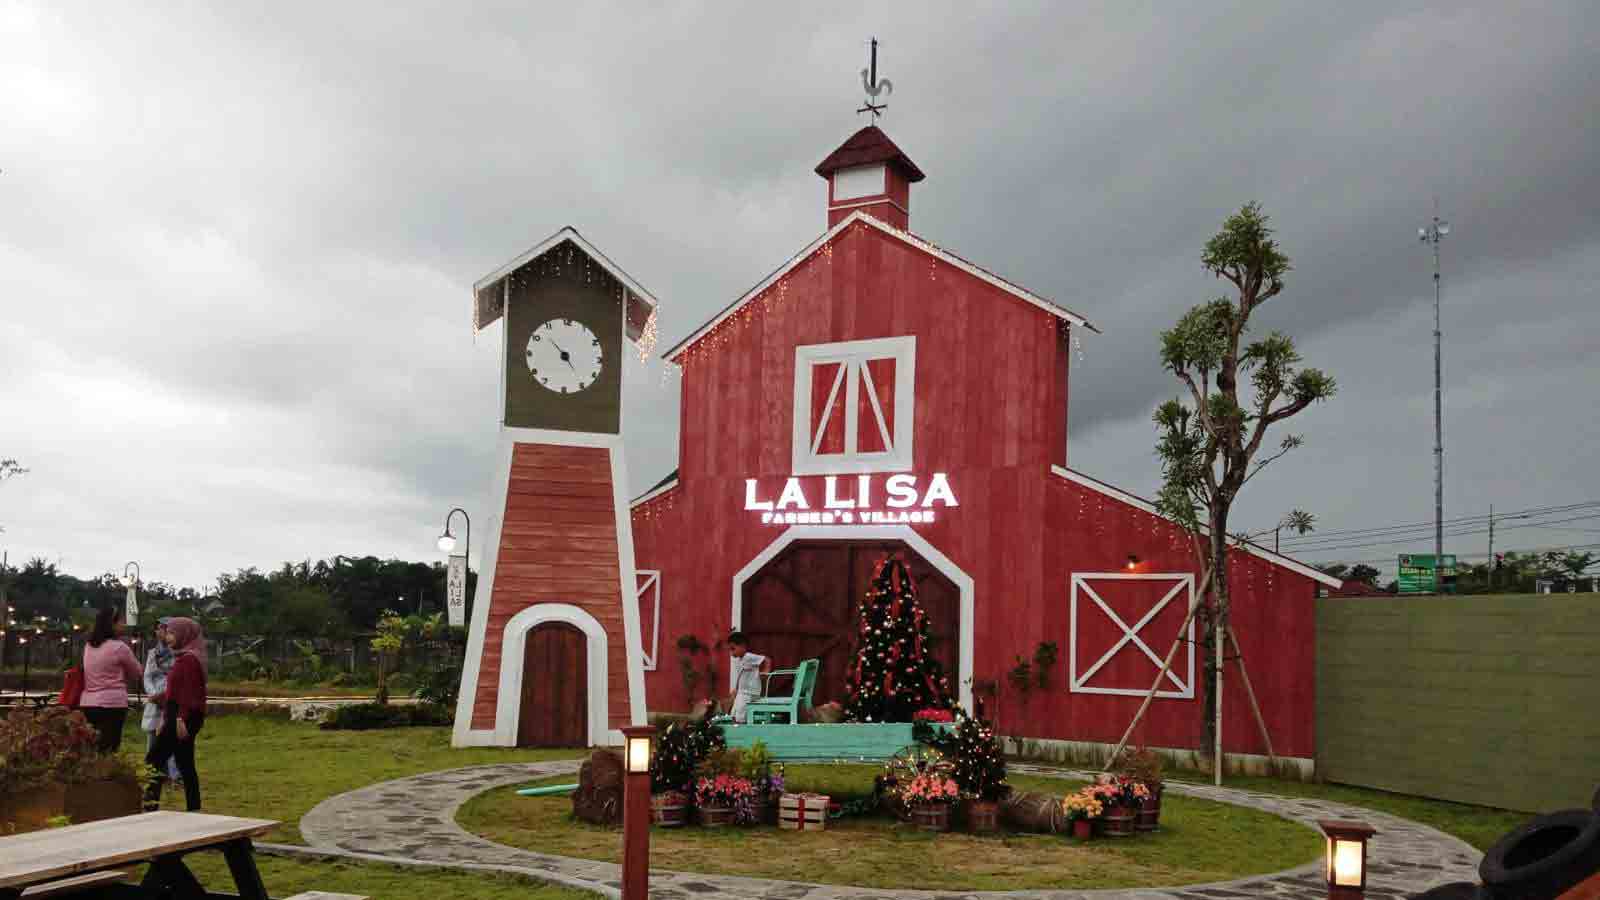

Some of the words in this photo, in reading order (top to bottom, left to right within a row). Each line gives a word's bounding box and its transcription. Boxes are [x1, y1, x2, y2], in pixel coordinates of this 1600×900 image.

[563, 319, 573, 327] 12
[744, 478, 810, 510] LA
[824, 475, 871, 509] LI
[886, 473, 959, 508] SA
[860, 511, 935, 523] VILLAGE
